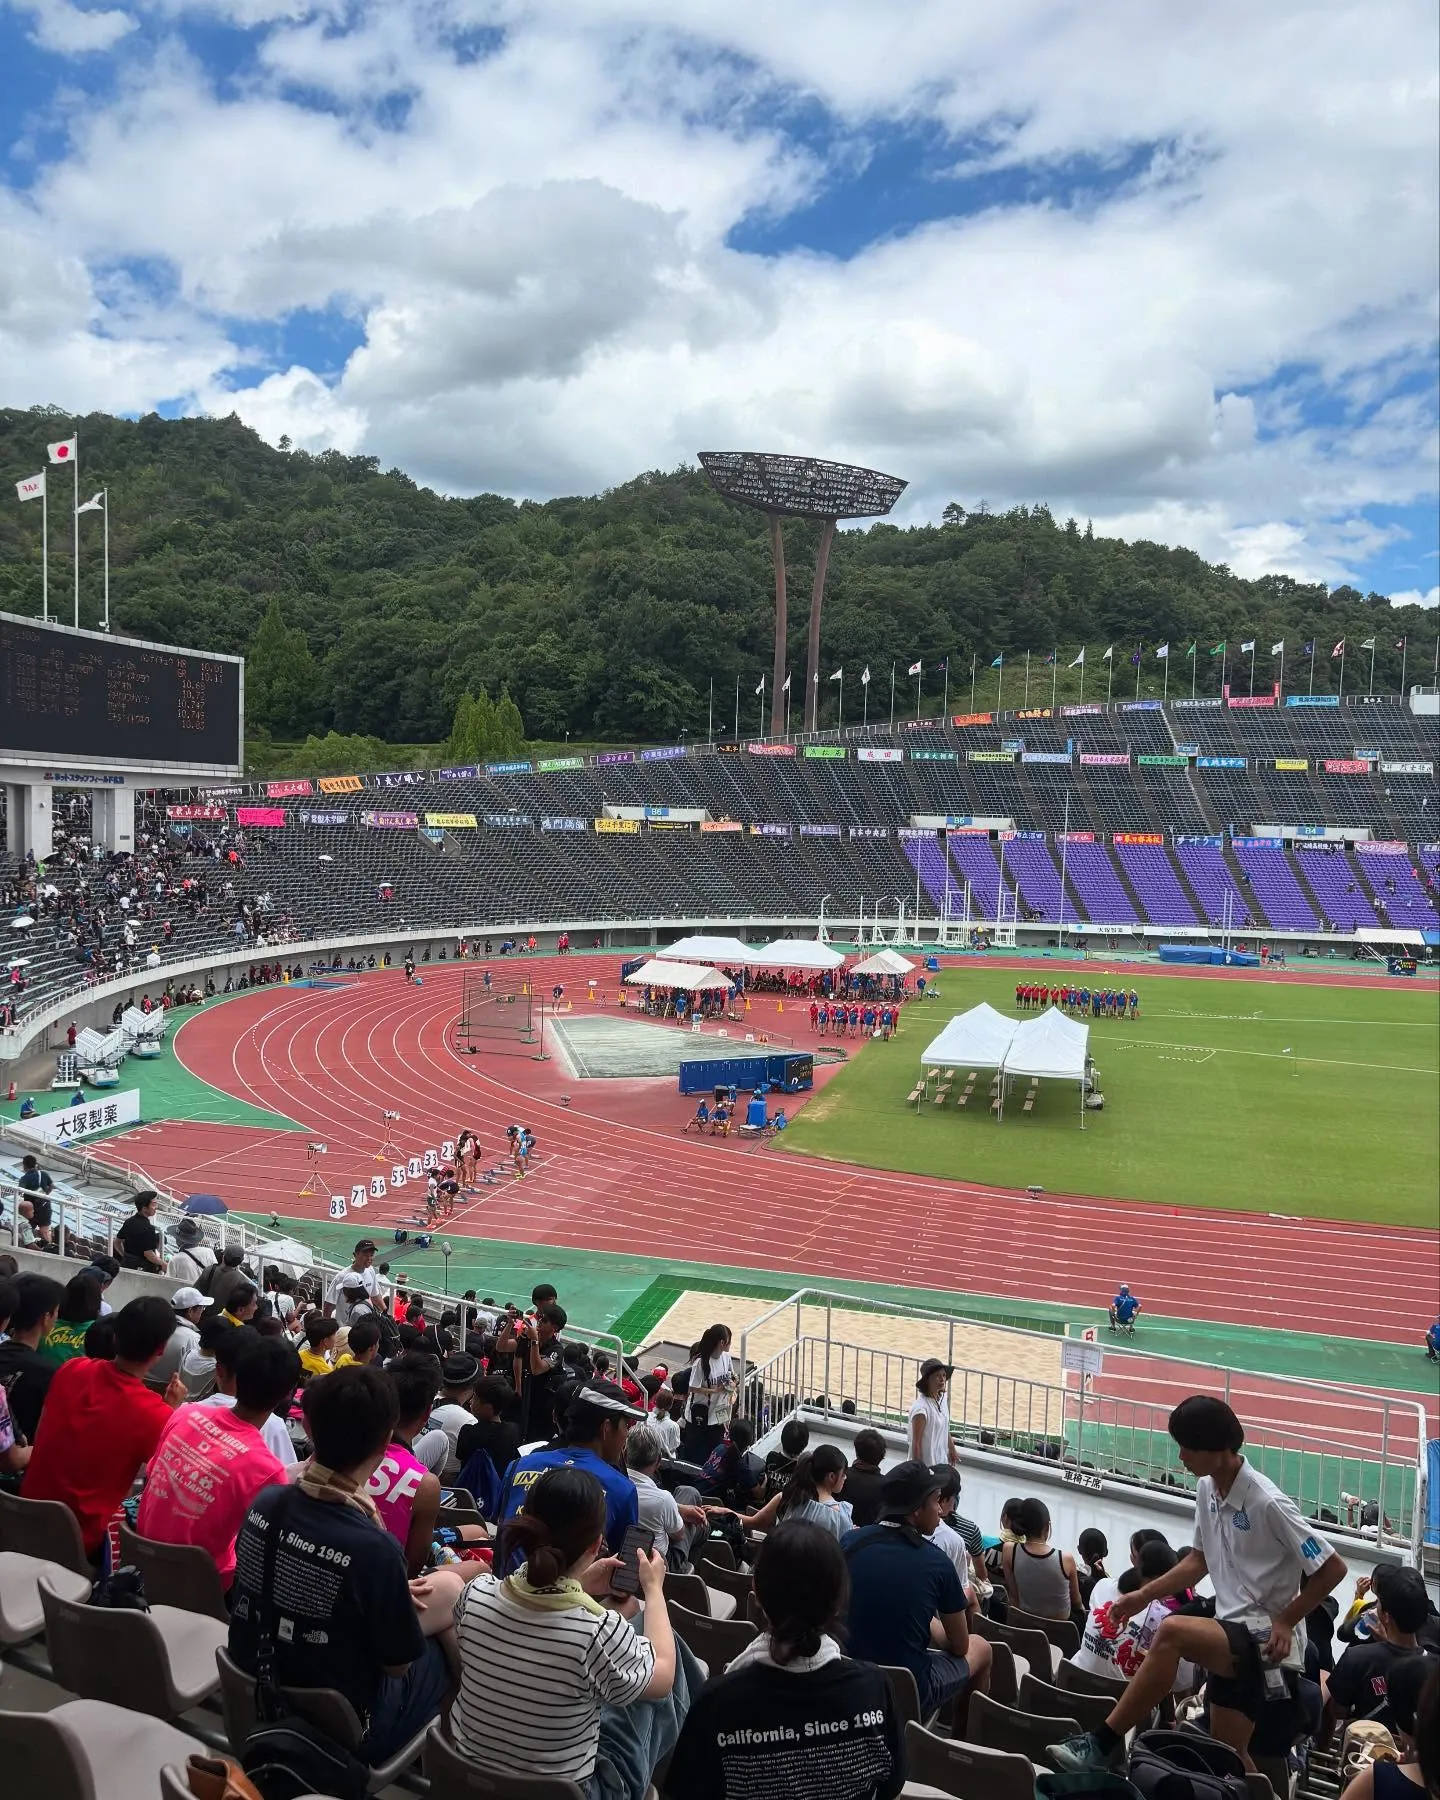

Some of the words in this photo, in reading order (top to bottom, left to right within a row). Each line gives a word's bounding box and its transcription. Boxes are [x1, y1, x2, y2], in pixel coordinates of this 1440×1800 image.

[1305, 826, 1316, 834] B4
[56, 1104, 118, 1140] 大塚製薬
[1064, 1470, 1102, 1489] 車椅子席
[286, 1531, 316, 1554] Since
[317, 1545, 352, 1568] 1966
[1301, 1536, 1322, 1560] 40
[1370, 1676, 1388, 1696] N
[717, 1726, 800, 1747] California,
[804, 1718, 849, 1737] Since
[853, 1709, 884, 1728] 1966
